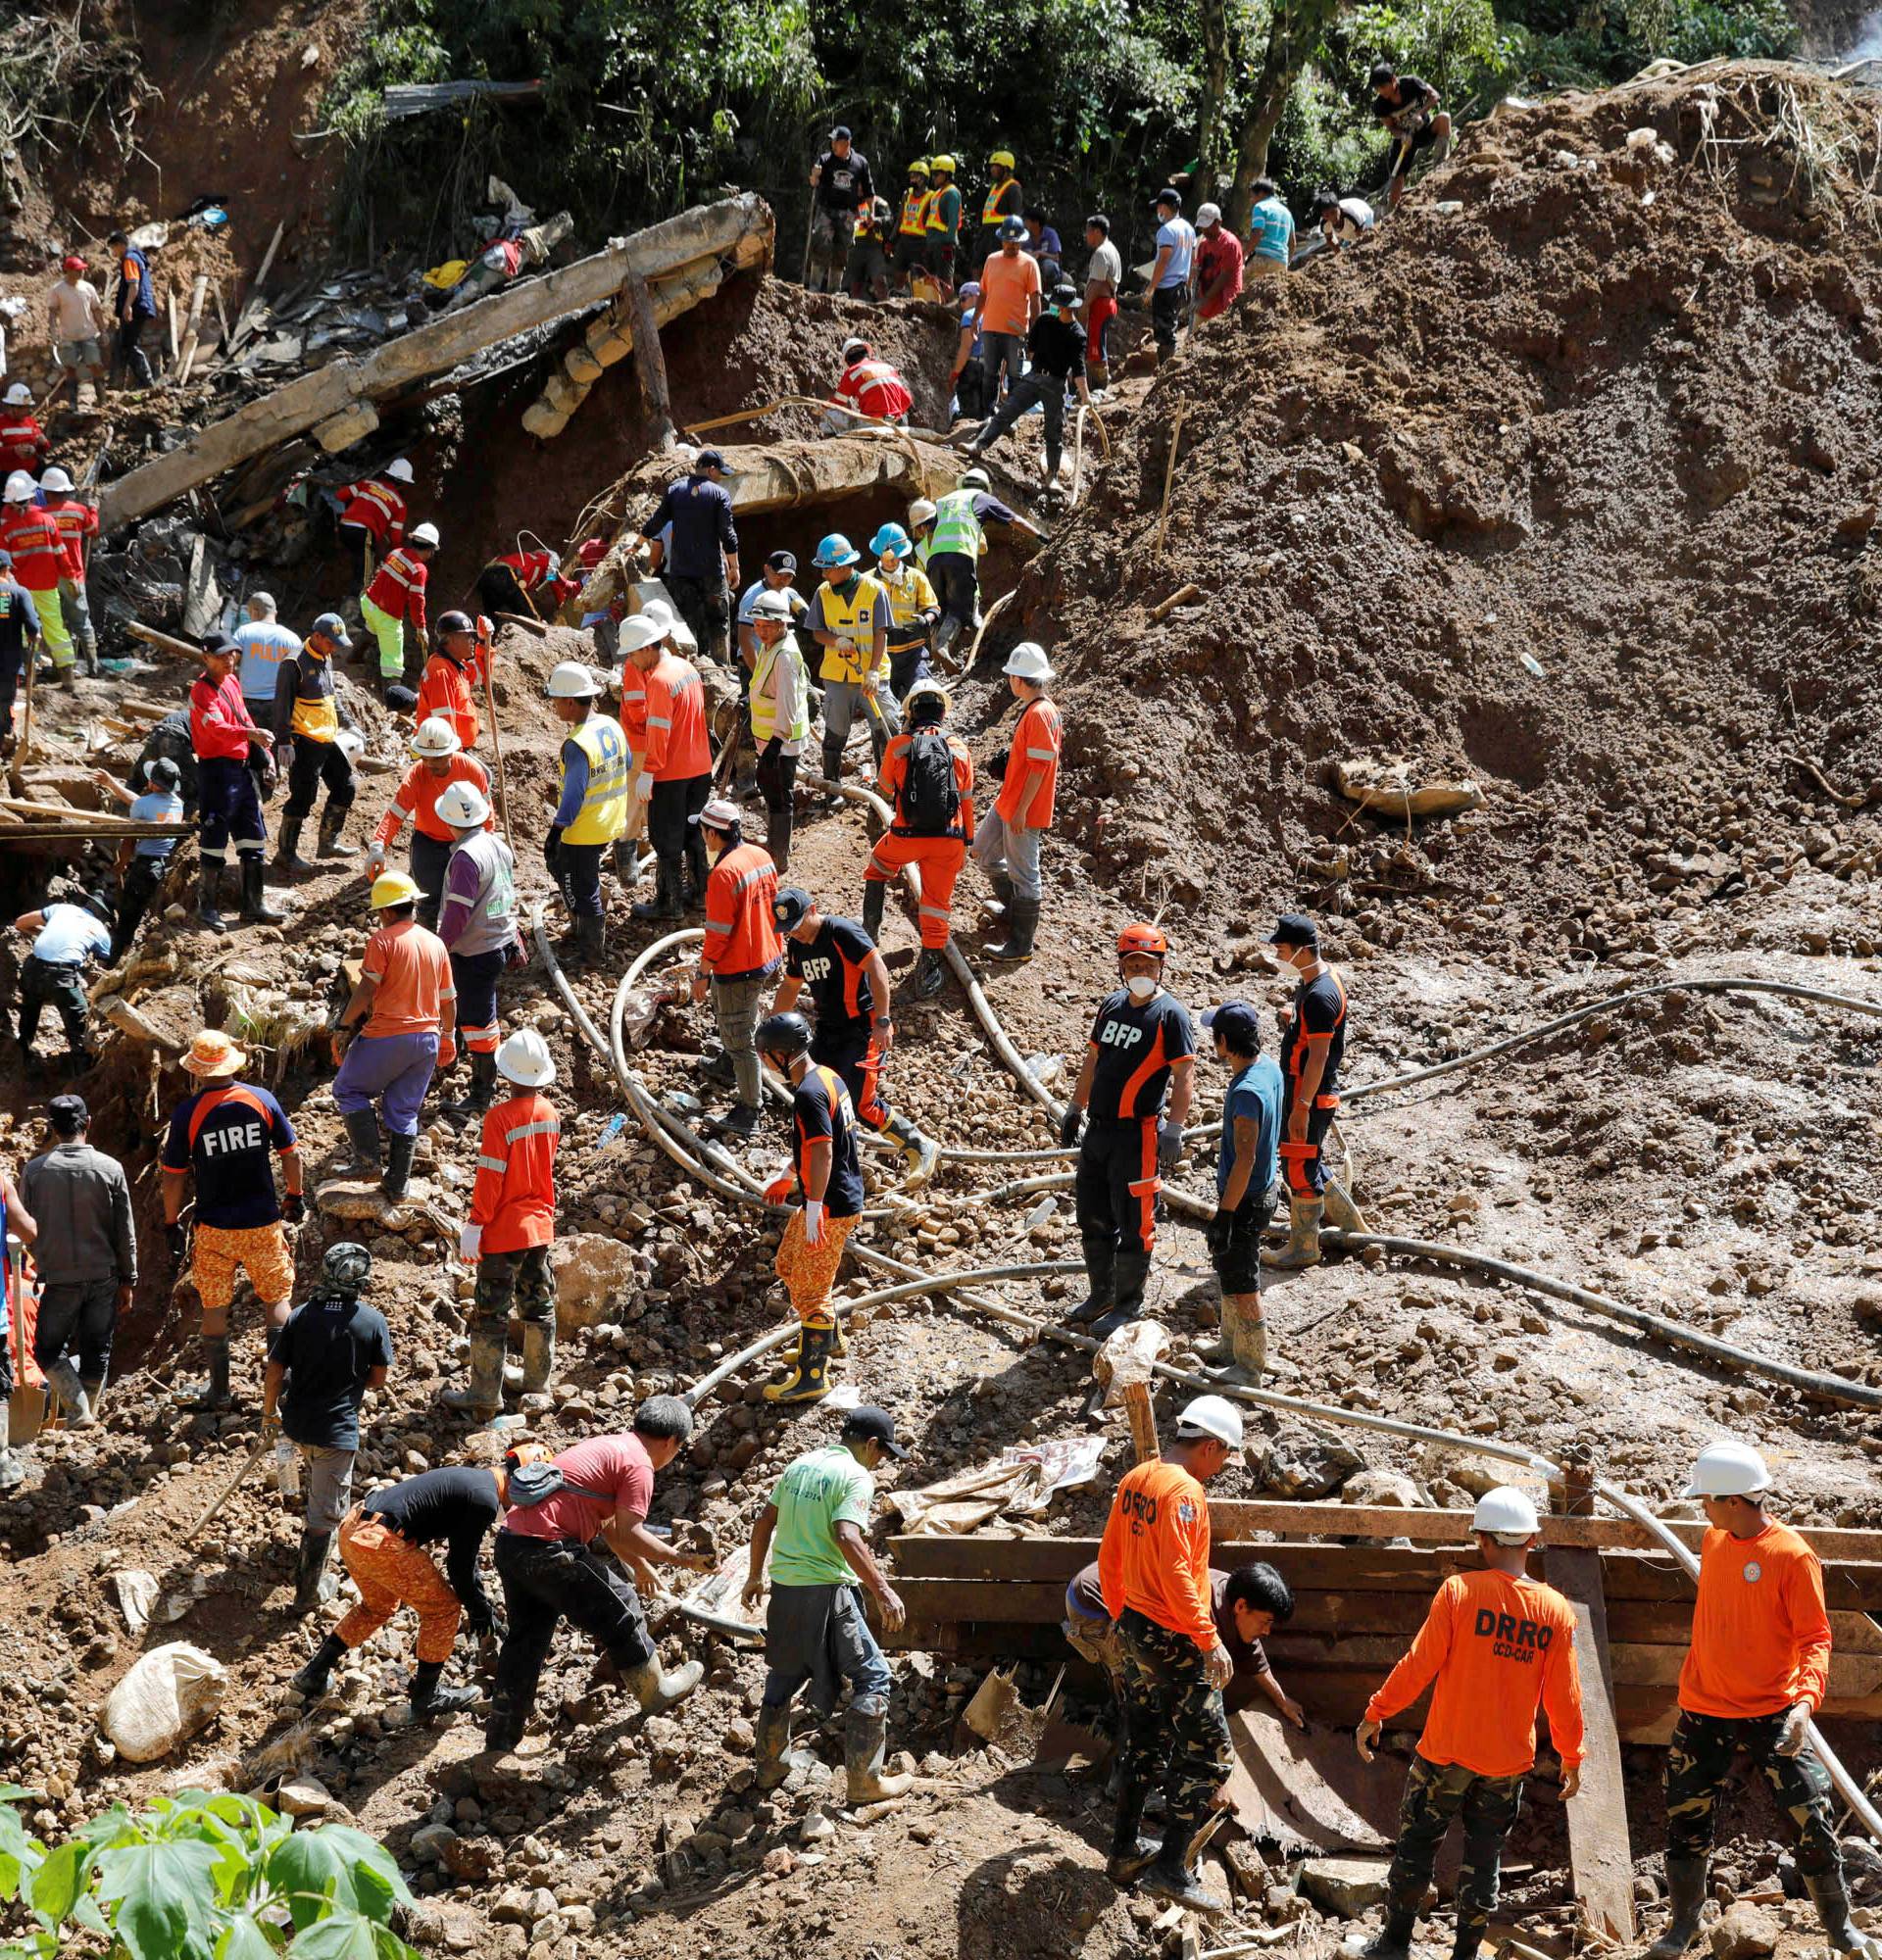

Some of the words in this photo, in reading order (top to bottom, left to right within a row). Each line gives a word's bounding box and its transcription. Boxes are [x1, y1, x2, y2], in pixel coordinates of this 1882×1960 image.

[801, 956, 831, 982] BFP
[1100, 1019, 1143, 1050] BFP
[202, 1122, 262, 1156] FIRE
[1474, 1608, 1553, 1650] DRRO
